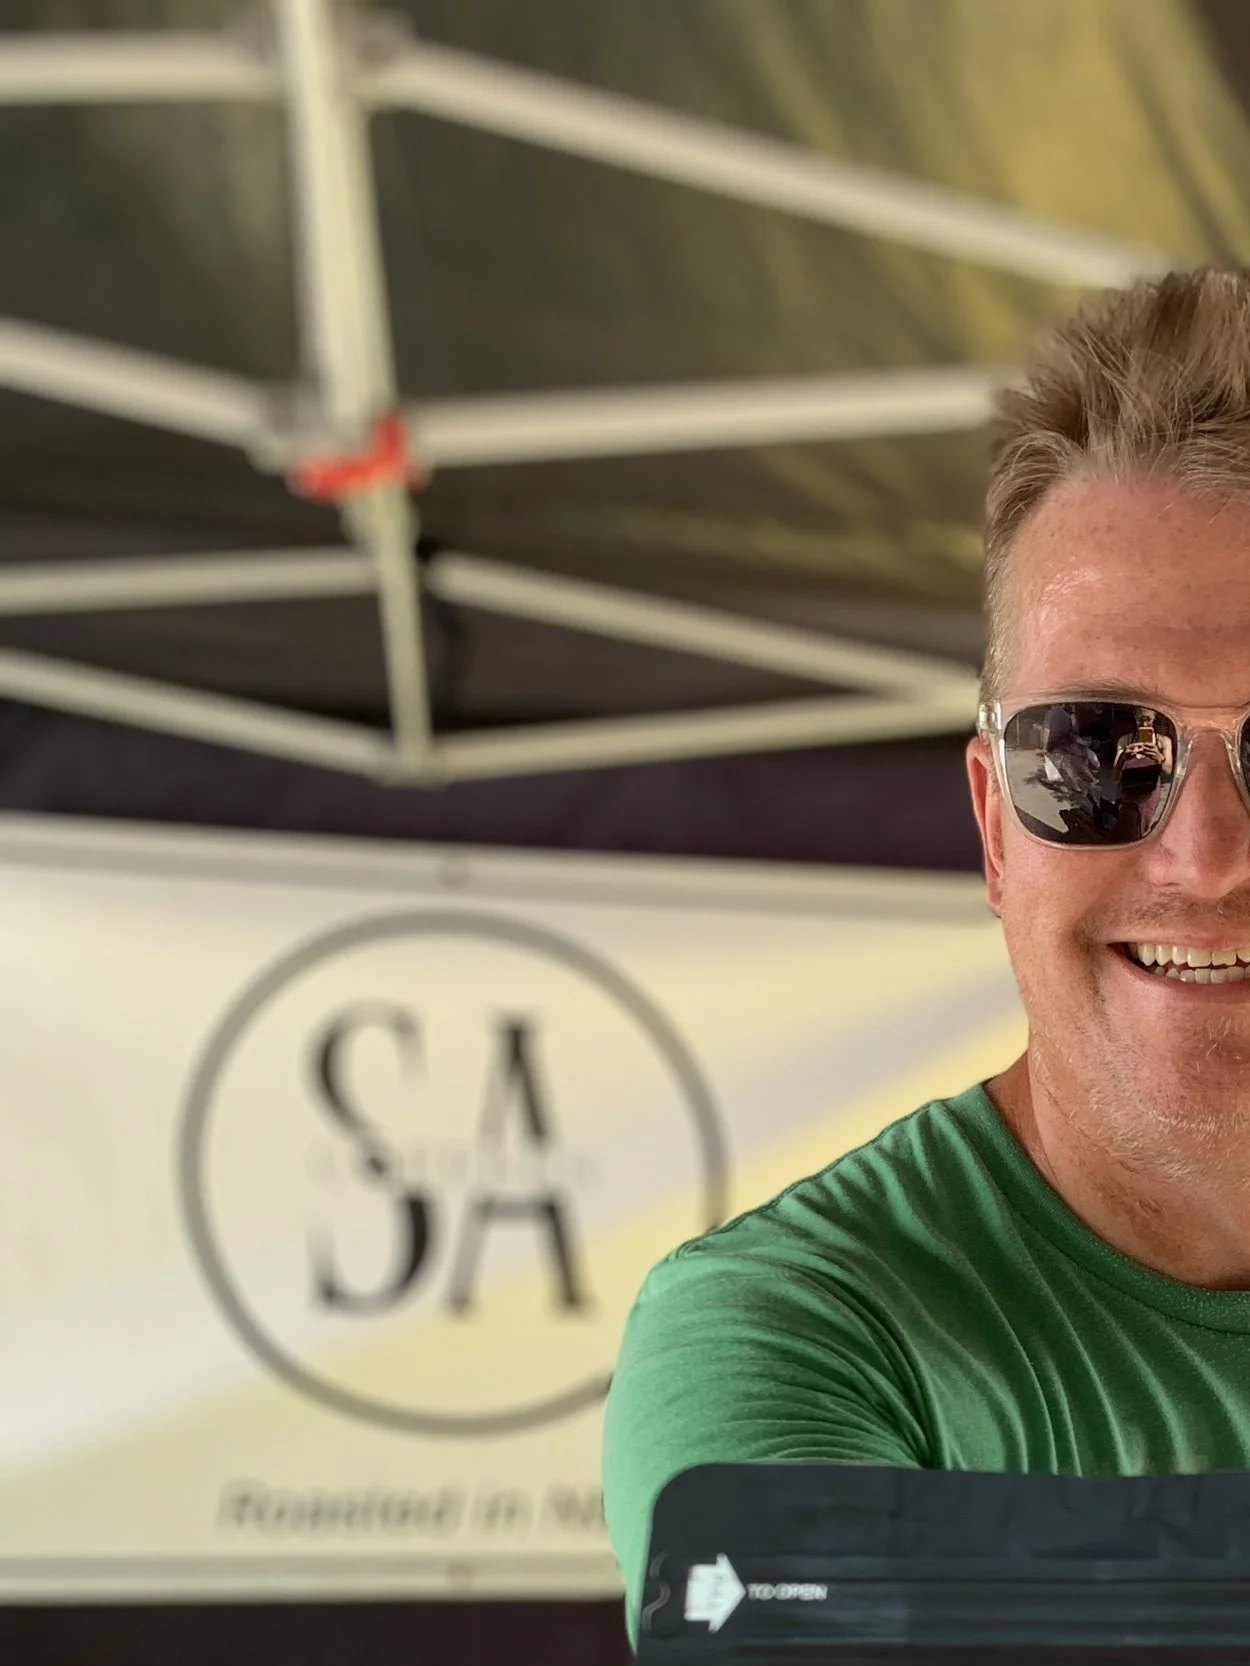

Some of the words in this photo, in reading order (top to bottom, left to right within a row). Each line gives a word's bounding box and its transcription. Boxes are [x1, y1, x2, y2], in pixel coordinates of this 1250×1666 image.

[308, 1002, 590, 1314] SA
[747, 1583, 774, 1601] TO
[775, 1583, 828, 1601] OPEN
